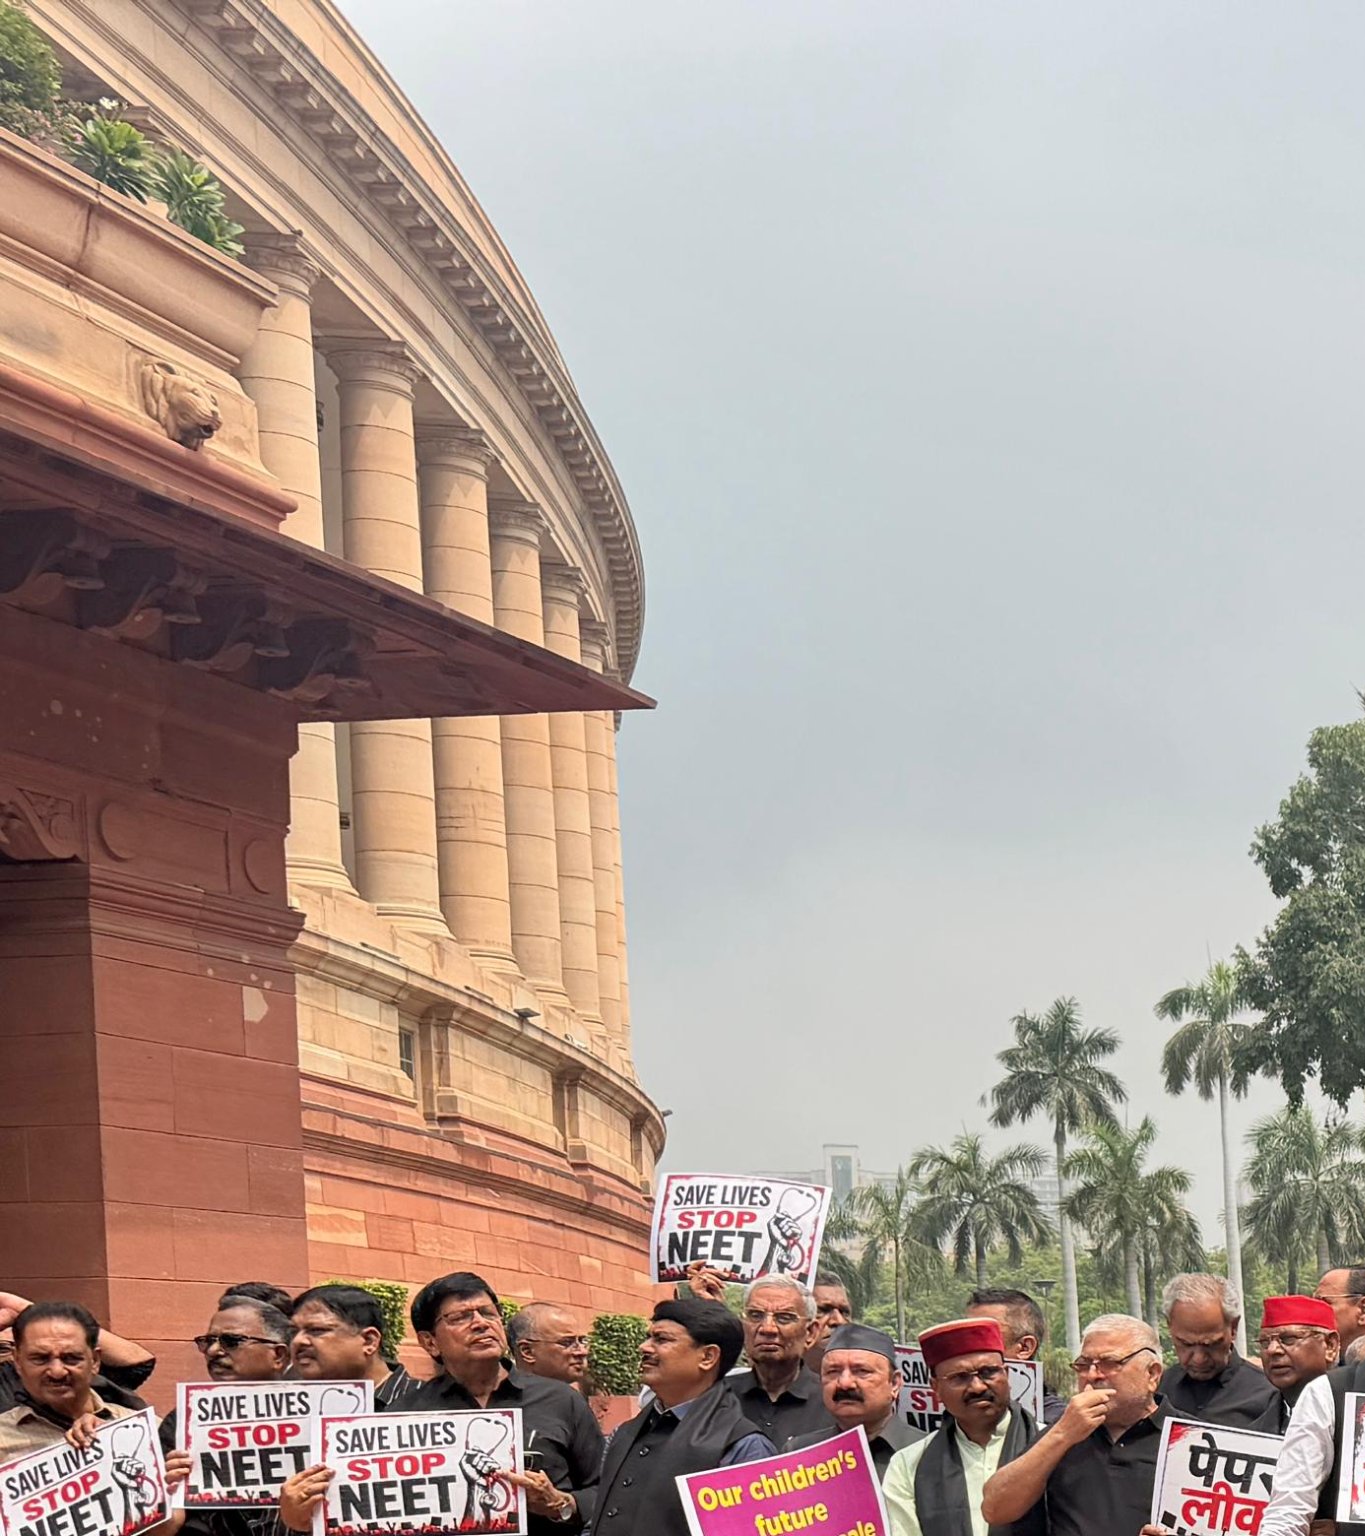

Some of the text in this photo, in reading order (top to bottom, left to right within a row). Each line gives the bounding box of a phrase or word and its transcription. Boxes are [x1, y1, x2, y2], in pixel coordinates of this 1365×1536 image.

[673, 1184, 772, 1207] SAVE LIVES
[677, 1210, 758, 1230] STOP
[668, 1229, 762, 1265] NEET
[901, 1360, 931, 1385] SAV
[197, 1391, 311, 1422] SAVE LIVES
[910, 1389, 941, 1412] ST
[207, 1422, 301, 1450] STOP
[335, 1420, 457, 1454] SAVE LIVES
[5, 1438, 104, 1500] SAVE LIVES
[199, 1445, 311, 1489] NEET
[346, 1452, 446, 1482] STOP
[697, 1449, 858, 1512] Our children's
[22, 1470, 100, 1521] STOP
[338, 1475, 457, 1522] NEET
